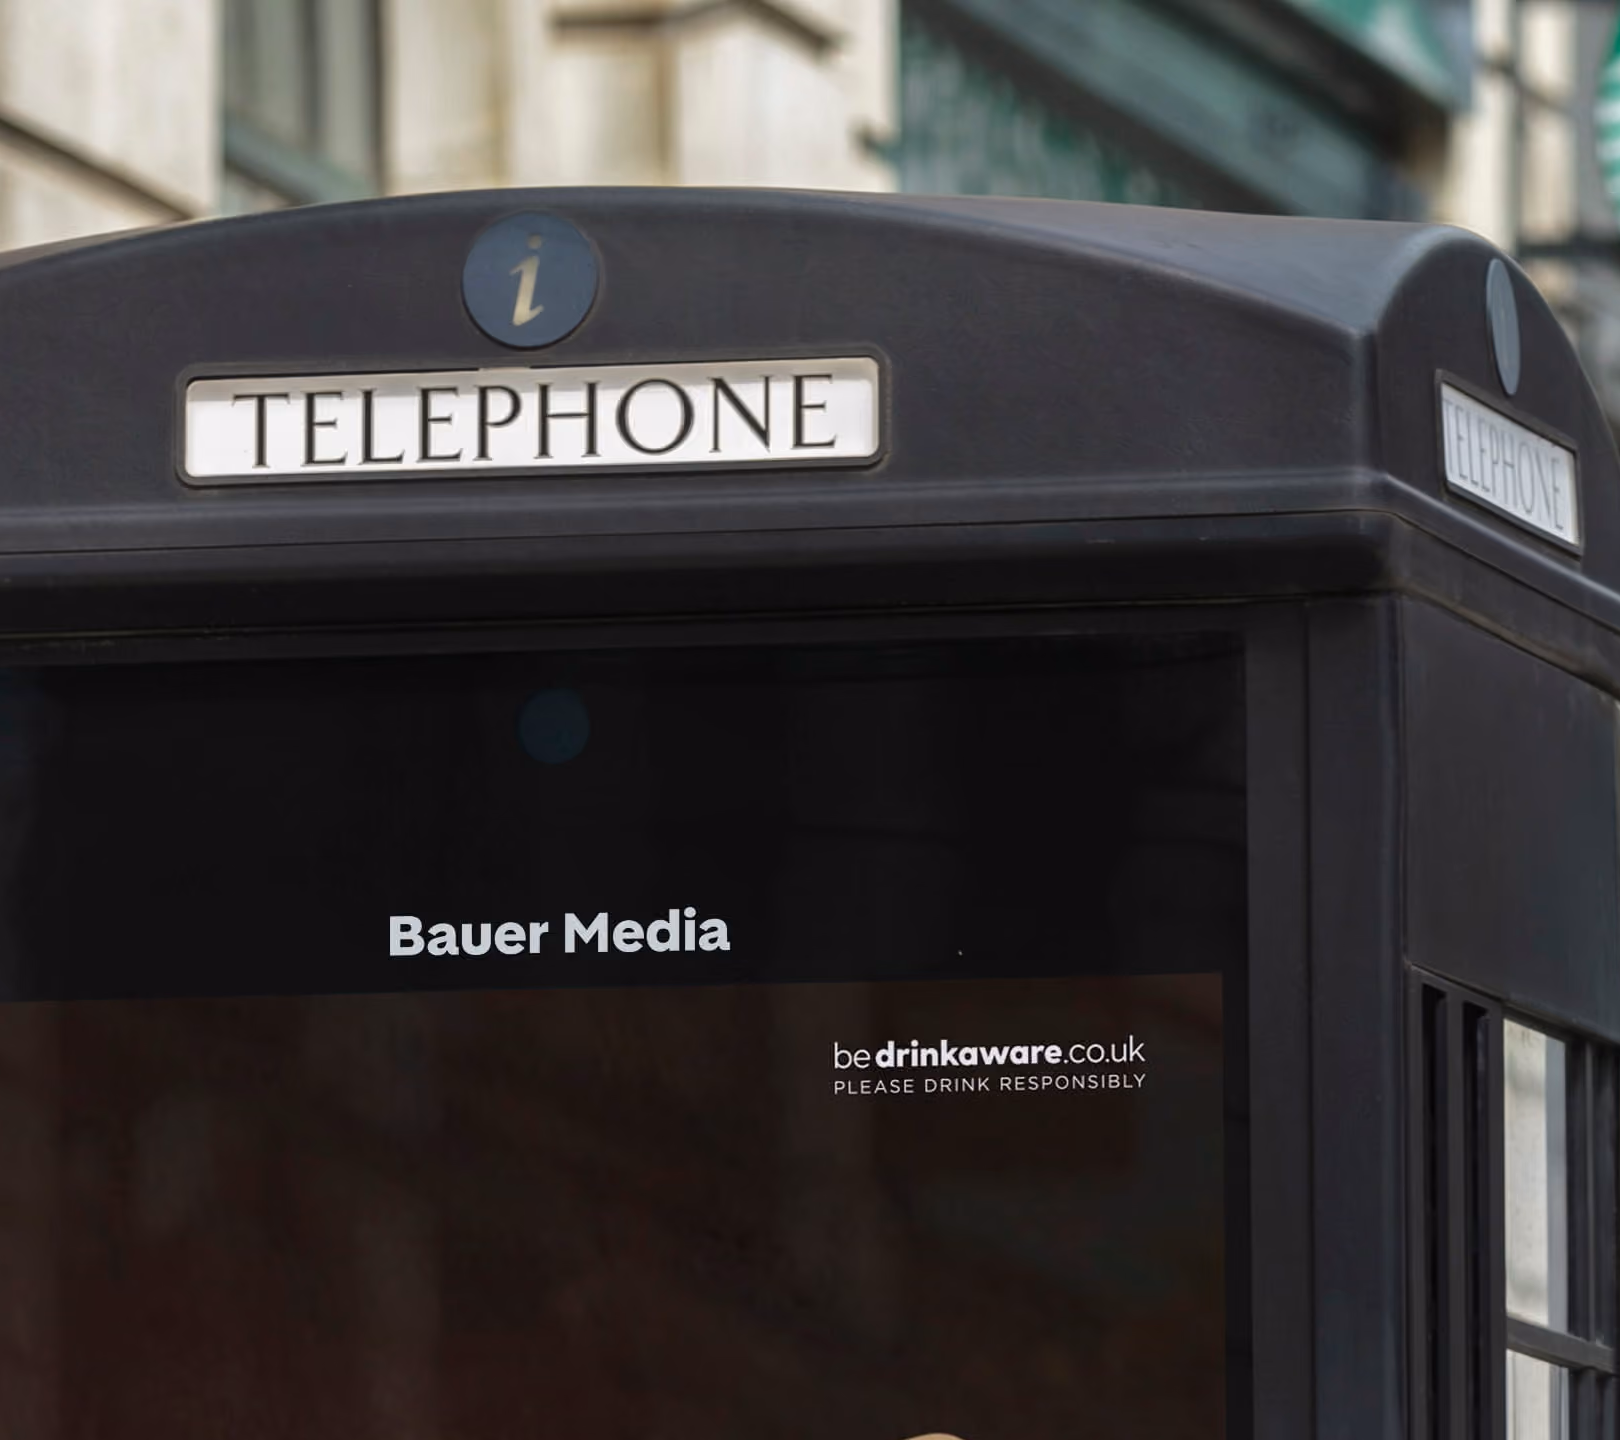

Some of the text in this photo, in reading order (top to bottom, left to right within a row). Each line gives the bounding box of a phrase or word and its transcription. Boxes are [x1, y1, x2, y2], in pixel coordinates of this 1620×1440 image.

[233, 373, 838, 469] TELEPHONE
[1444, 399, 1564, 531] TELEPHONE
[388, 906, 731, 957] Bauer Media
[834, 1073, 1147, 1095] PLEASE DRINK RESPONSIBLY
